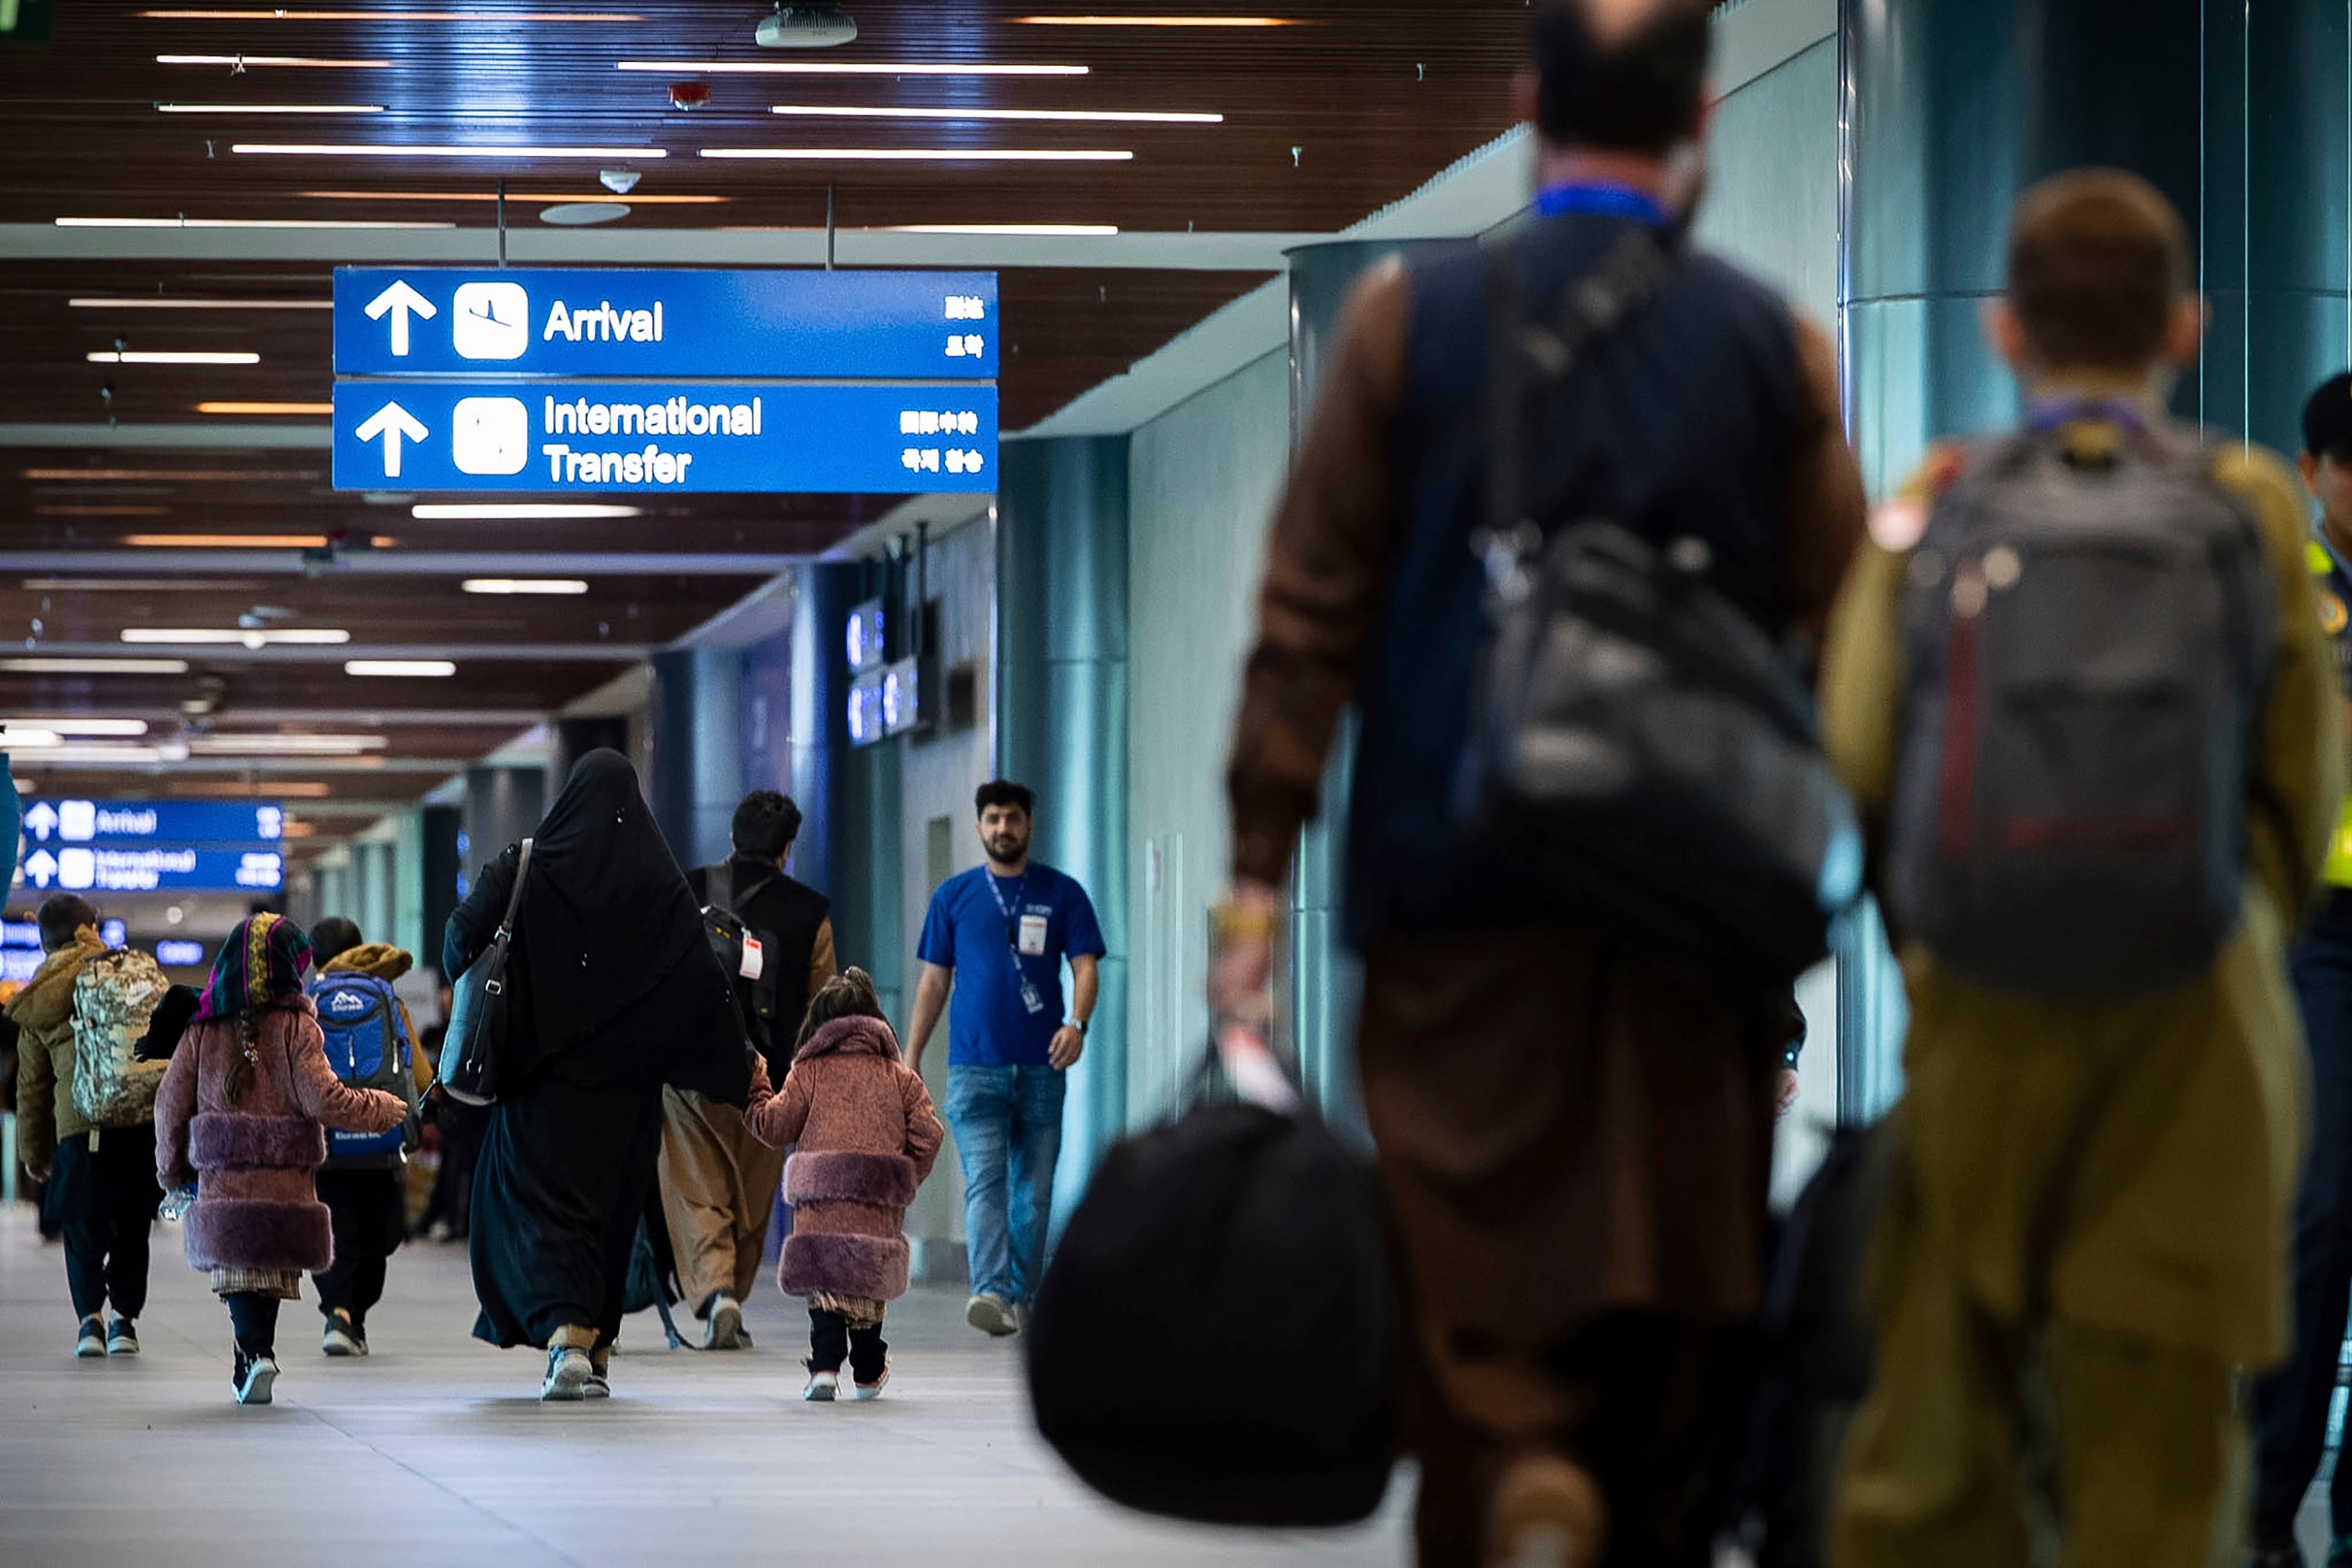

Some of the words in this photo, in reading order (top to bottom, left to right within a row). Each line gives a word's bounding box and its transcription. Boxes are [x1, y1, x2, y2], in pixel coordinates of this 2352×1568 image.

[543, 300, 663, 342] Arrival
[544, 396, 761, 436] International
[543, 445, 692, 484] Transfer
